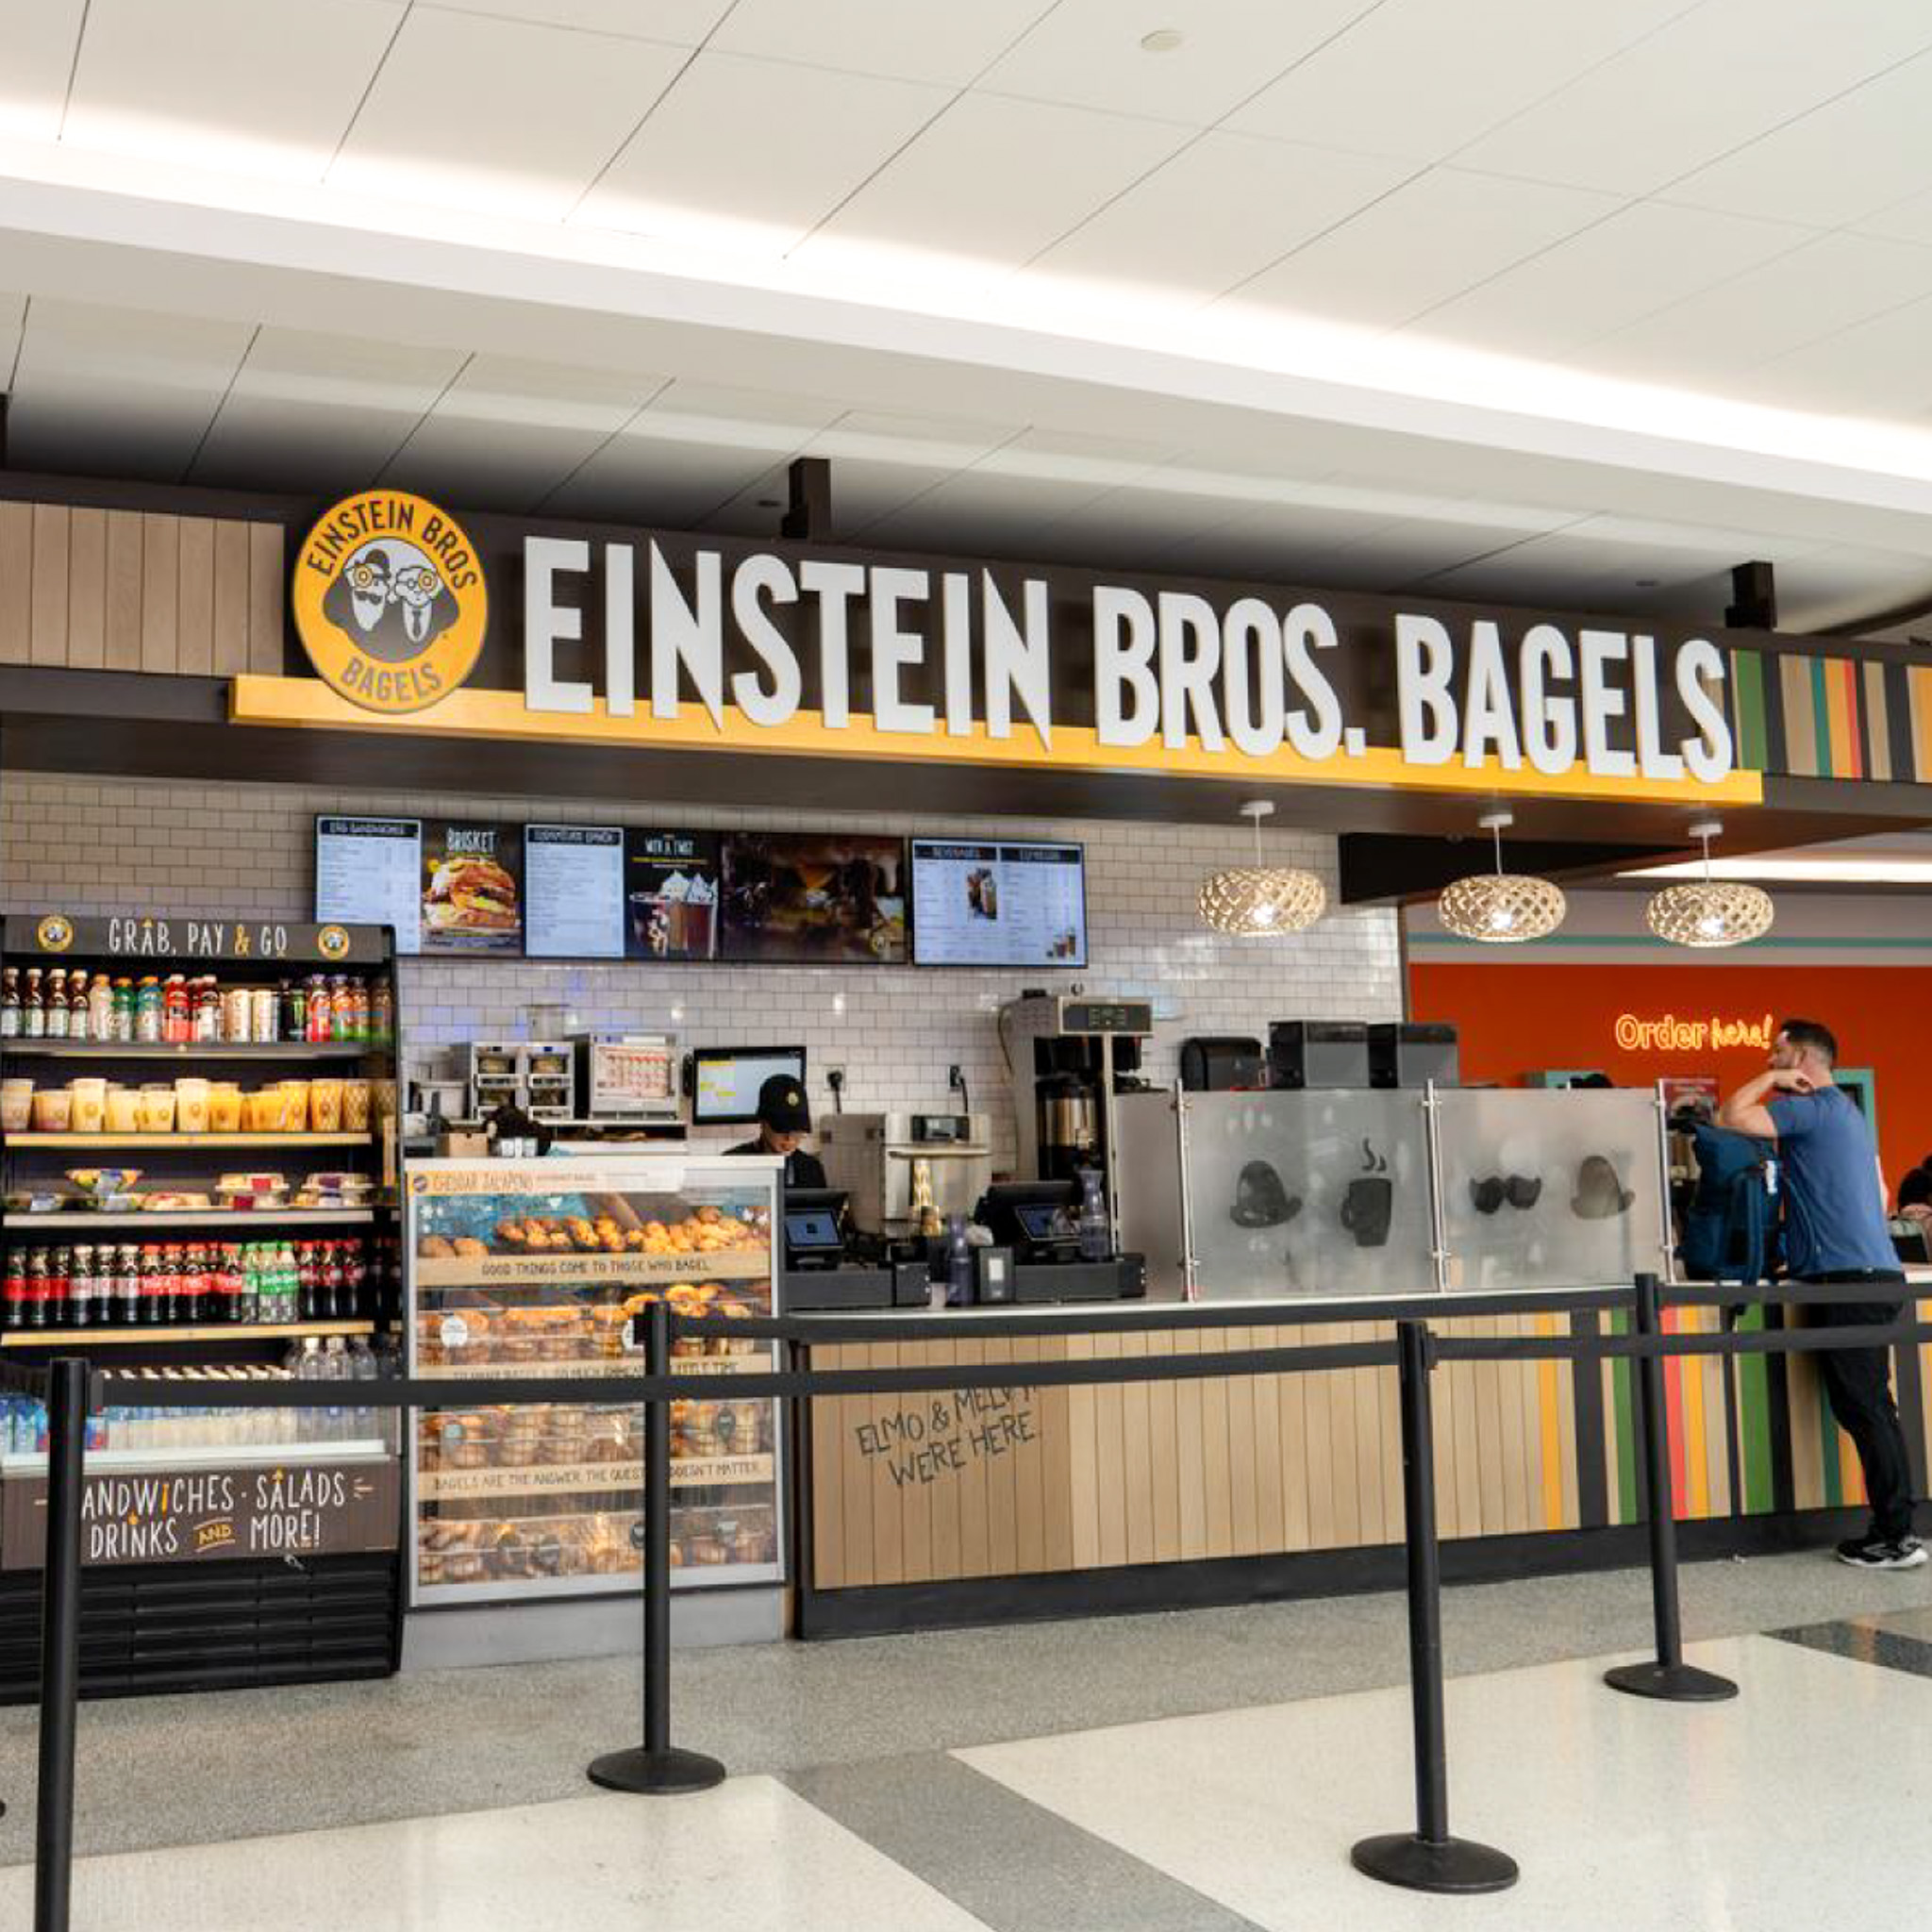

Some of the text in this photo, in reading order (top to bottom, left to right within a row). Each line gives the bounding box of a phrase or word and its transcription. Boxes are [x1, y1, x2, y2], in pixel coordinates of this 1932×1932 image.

[308, 500, 478, 590] EINSTEIN BROS
[341, 658, 441, 702] BAGELS
[523, 534, 1735, 784] EINSTEIN BROS. BAGELS
[188, 926, 224, 953] PAY
[234, 925, 250, 957] &
[260, 925, 288, 957] GO
[1616, 1014, 1774, 1050] Order here!
[481, 1263, 511, 1275] GOOD
[516, 1262, 557, 1274] THINGS
[559, 1260, 587, 1274] COME
[592, 1260, 607, 1272] TO
[610, 1259, 644, 1273] THOSE
[648, 1259, 672, 1271] WHO
[856, 1411, 924, 1456] ELMO
[931, 1400, 950, 1433] &
[888, 1409, 1037, 1486] WERE HERE
[81, 1465, 345, 1521] ANDWICHES SALADS
[91, 1509, 321, 1560] DRINKS AND MORE!
